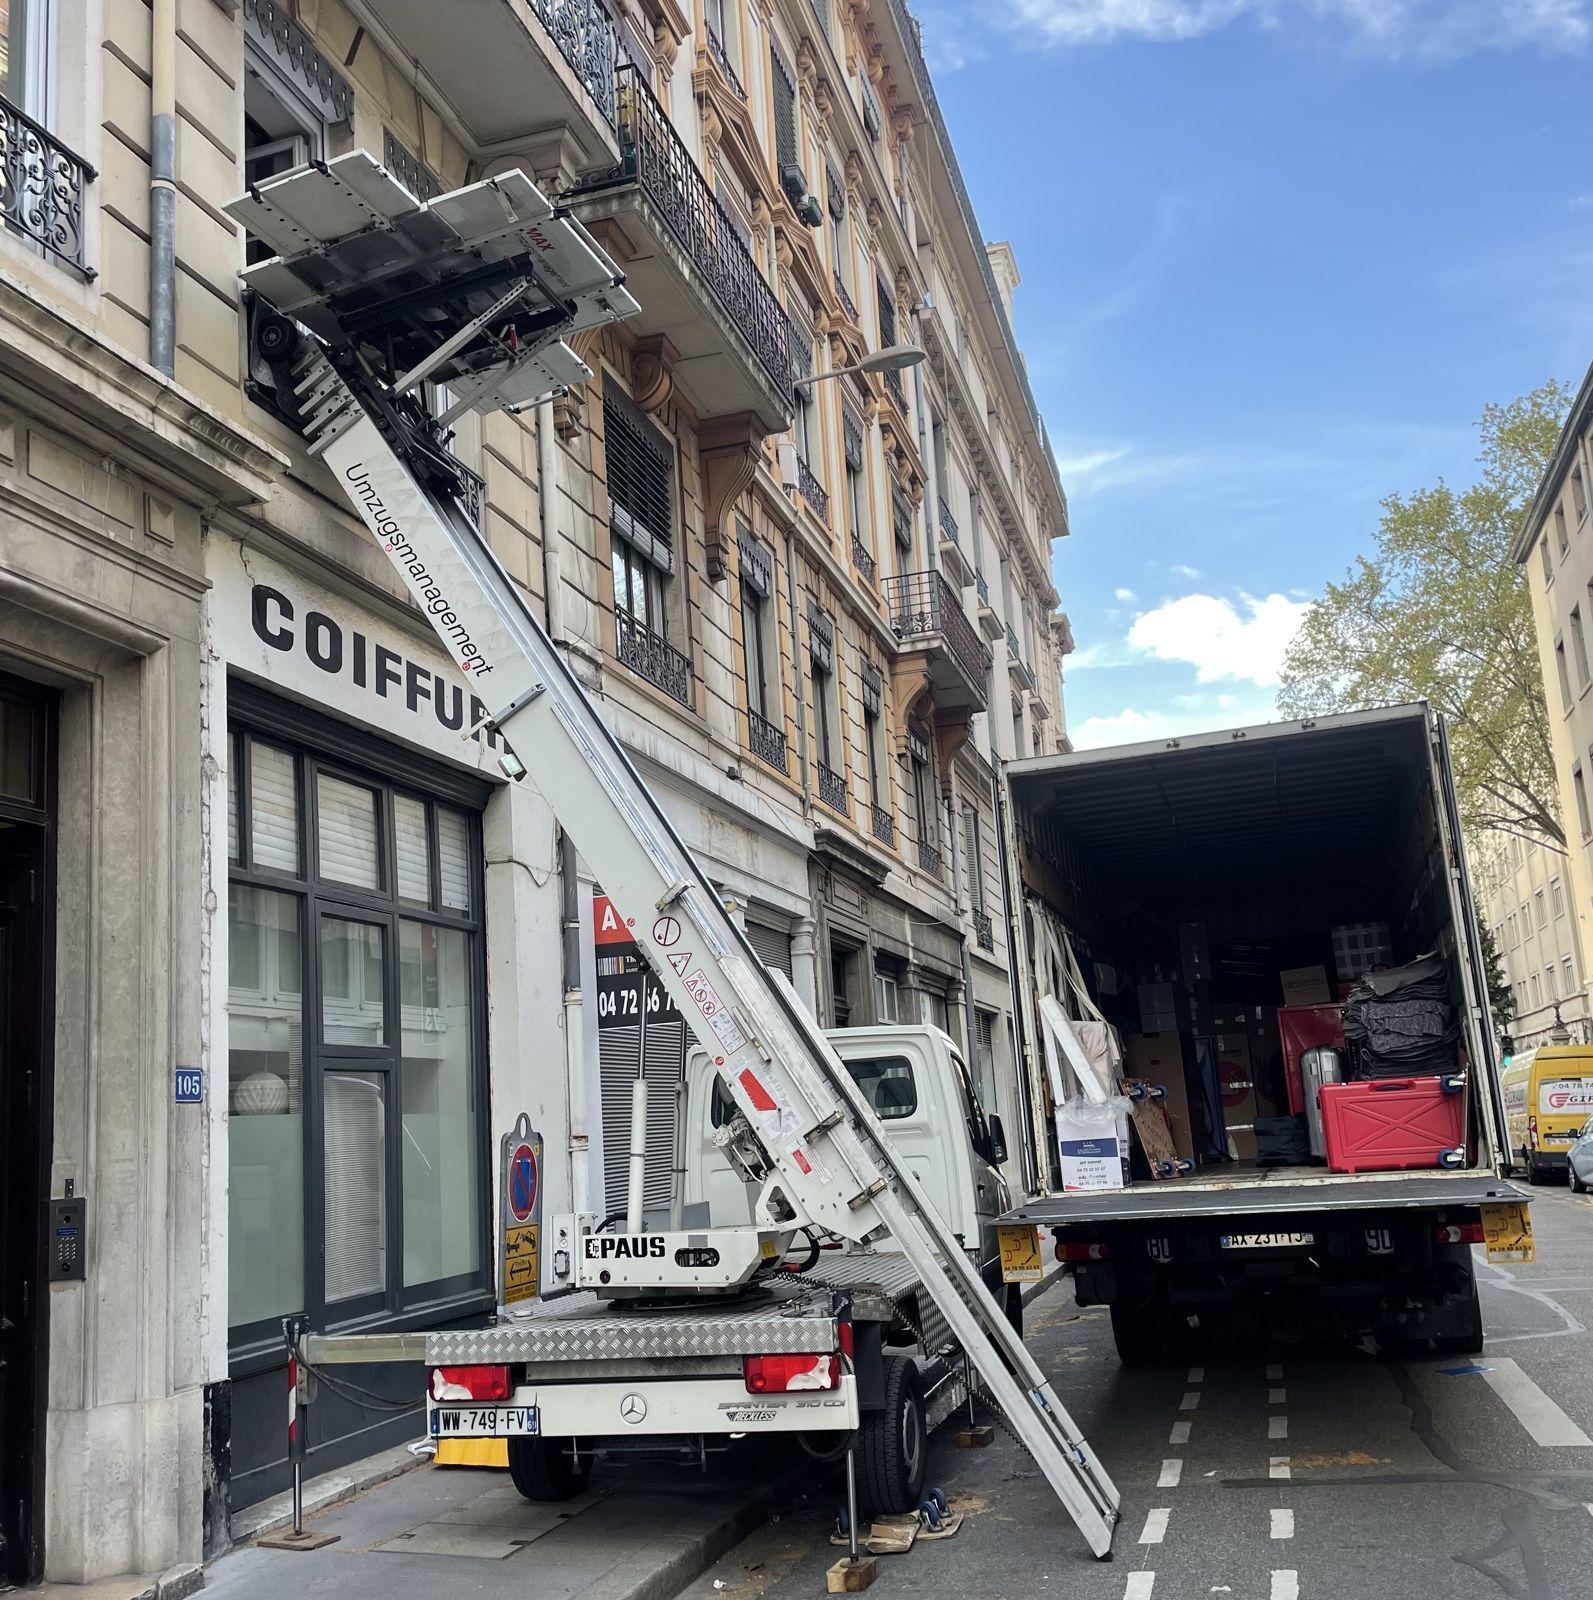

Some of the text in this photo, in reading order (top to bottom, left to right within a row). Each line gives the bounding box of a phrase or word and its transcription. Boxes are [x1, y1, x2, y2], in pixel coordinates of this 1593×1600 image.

[526, 227, 556, 252] MAX
[345, 462, 495, 678] Umzugsmanagement
[251, 583, 514, 754] COIFFUR
[601, 904, 618, 932] A
[598, 991, 617, 1018] 04
[620, 988, 638, 1015] 72
[177, 1075, 200, 1096] 105
[600, 1236, 666, 1259] PAUS
[717, 1401, 788, 1410] SPRINTER
[823, 1399, 847, 1407] CDI
[734, 1411, 777, 1421] RECKLESS
[441, 1410, 525, 1431] WW-749-FV
